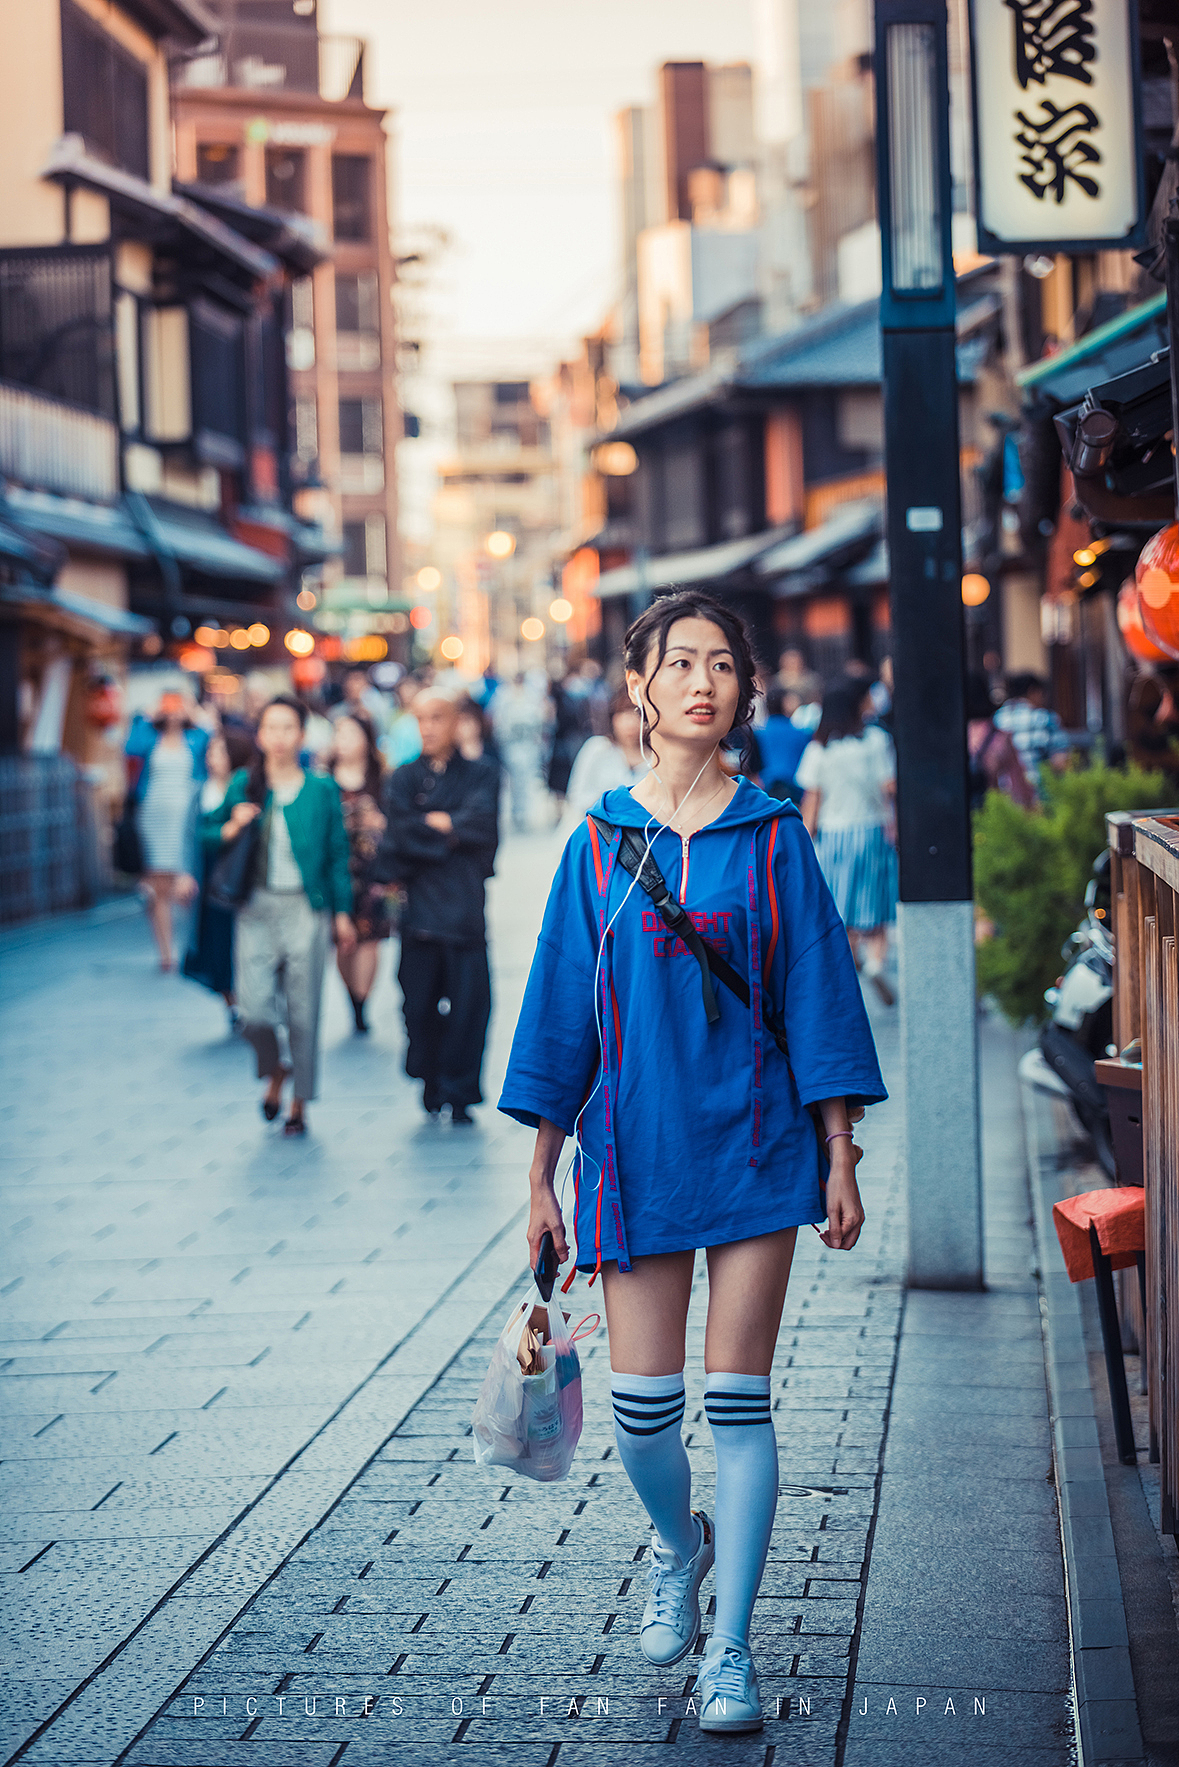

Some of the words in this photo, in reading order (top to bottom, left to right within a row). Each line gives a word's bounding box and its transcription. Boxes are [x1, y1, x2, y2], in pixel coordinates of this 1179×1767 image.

[751, 922, 759, 970] DAYNIGHT
[752, 1098, 761, 1147] DAYNIGHT
[606, 1144, 617, 1191] DAYNIGHT
[612, 1203, 625, 1250] DAYNIGHT
